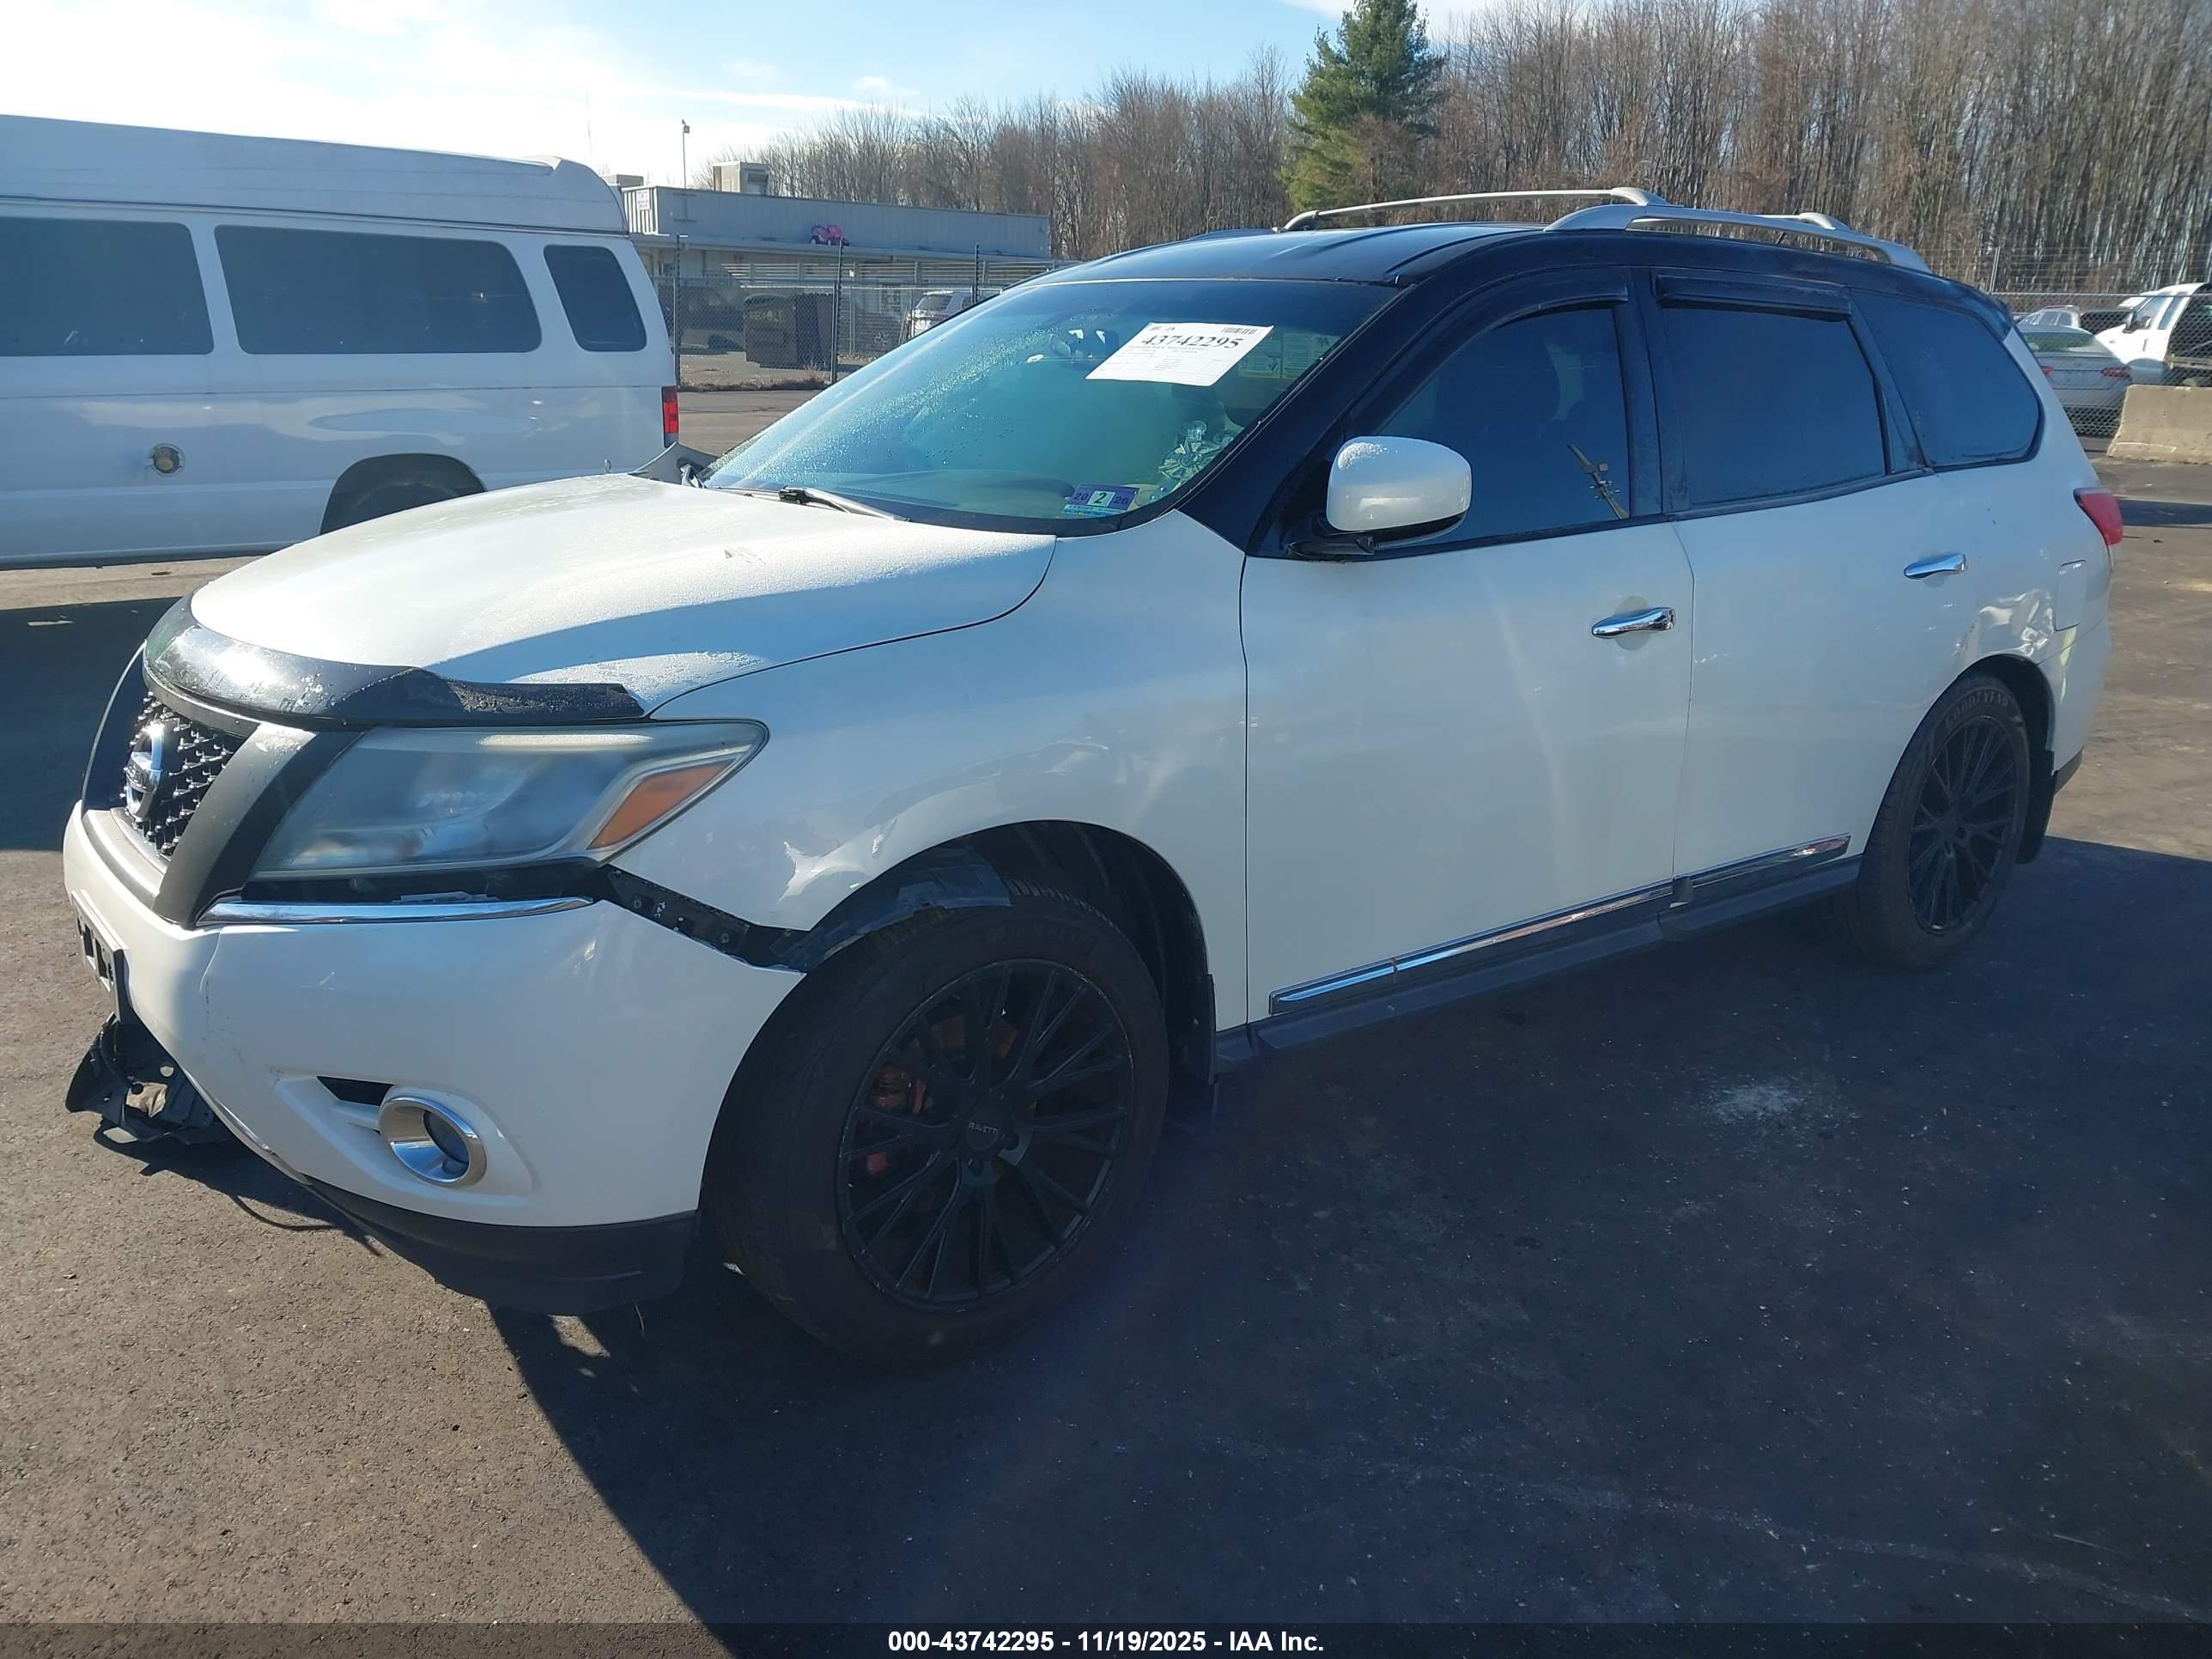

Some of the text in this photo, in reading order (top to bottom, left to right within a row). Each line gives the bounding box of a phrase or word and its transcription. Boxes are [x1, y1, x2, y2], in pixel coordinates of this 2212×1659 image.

[1141, 335, 1243, 349] 43742295
[1074, 492, 1130, 505] 20 2 26
